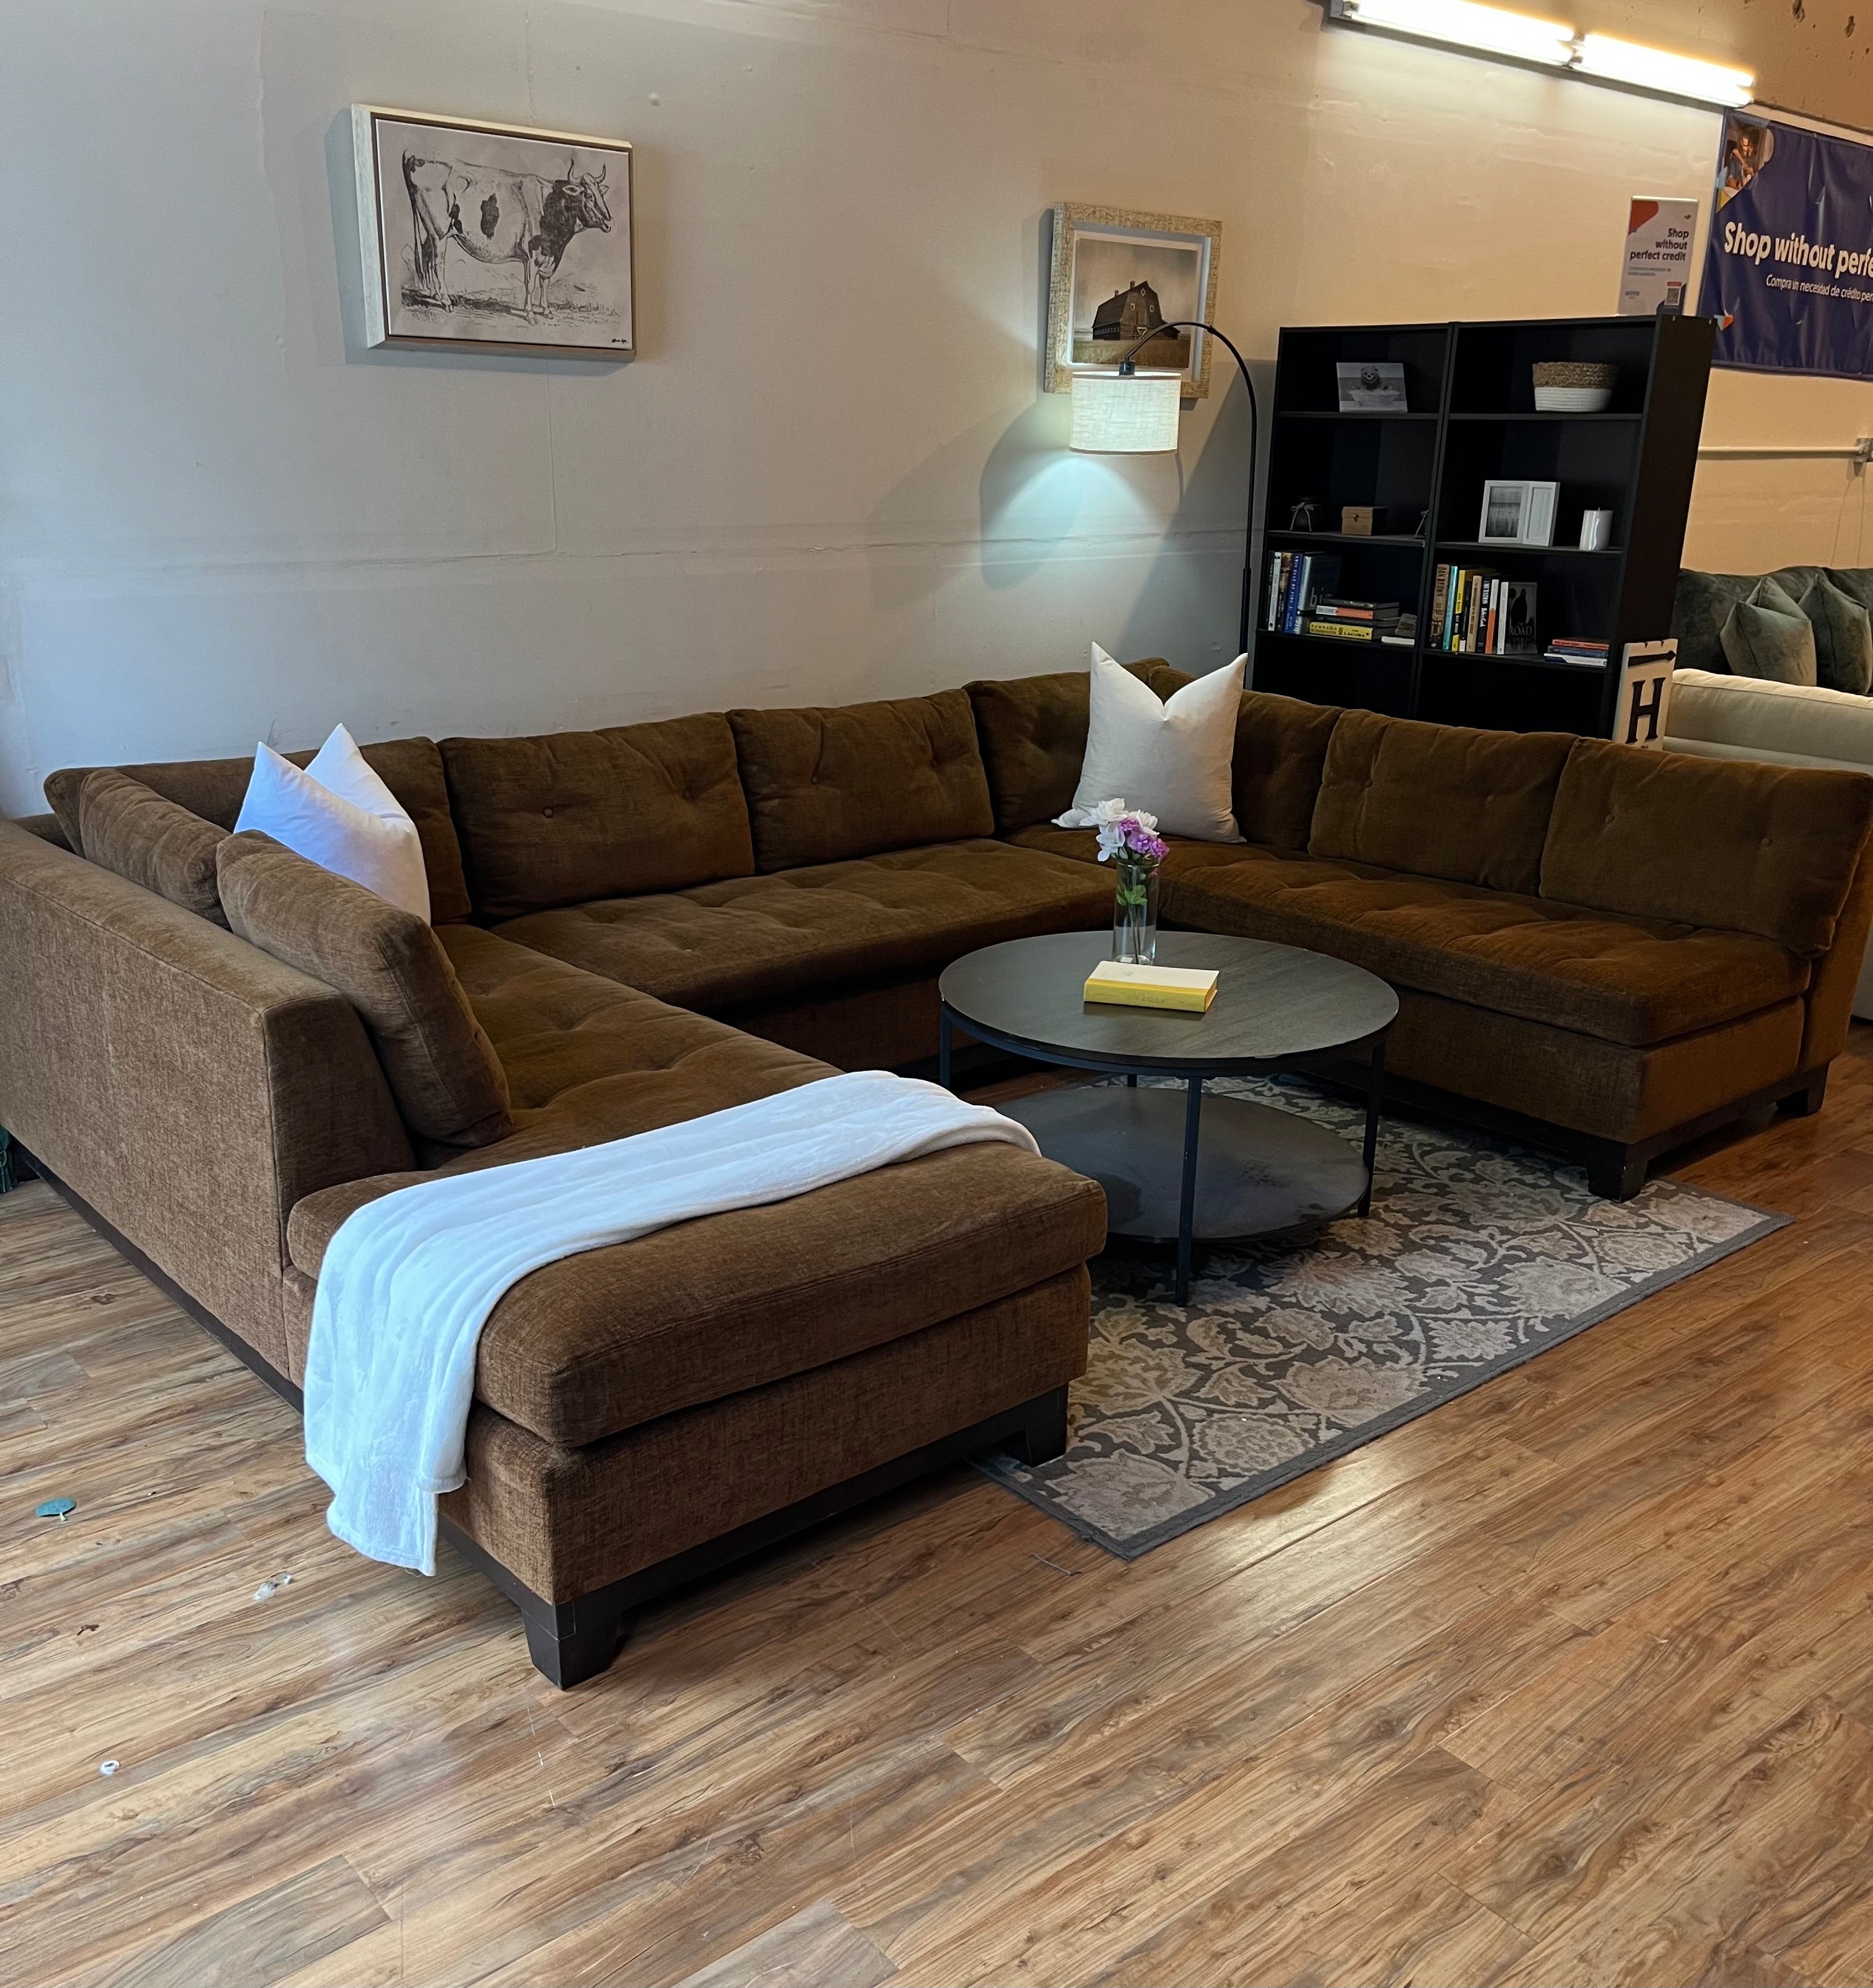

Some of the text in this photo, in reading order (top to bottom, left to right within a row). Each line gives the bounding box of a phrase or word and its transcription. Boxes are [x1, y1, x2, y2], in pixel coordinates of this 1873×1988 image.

[1667, 227, 1690, 240] Shop
[1655, 239, 1688, 250] without
[1724, 221, 1771, 265] Shop
[1775, 232, 1835, 271] without
[1630, 250, 1687, 261] perfect credit
[1766, 274, 1792, 291] Compra
[1800, 281, 1830, 296] necesidad
[1830, 285, 1840, 297] de
[1509, 626, 1532, 636] ROAD
[1618, 677, 1666, 744] H
